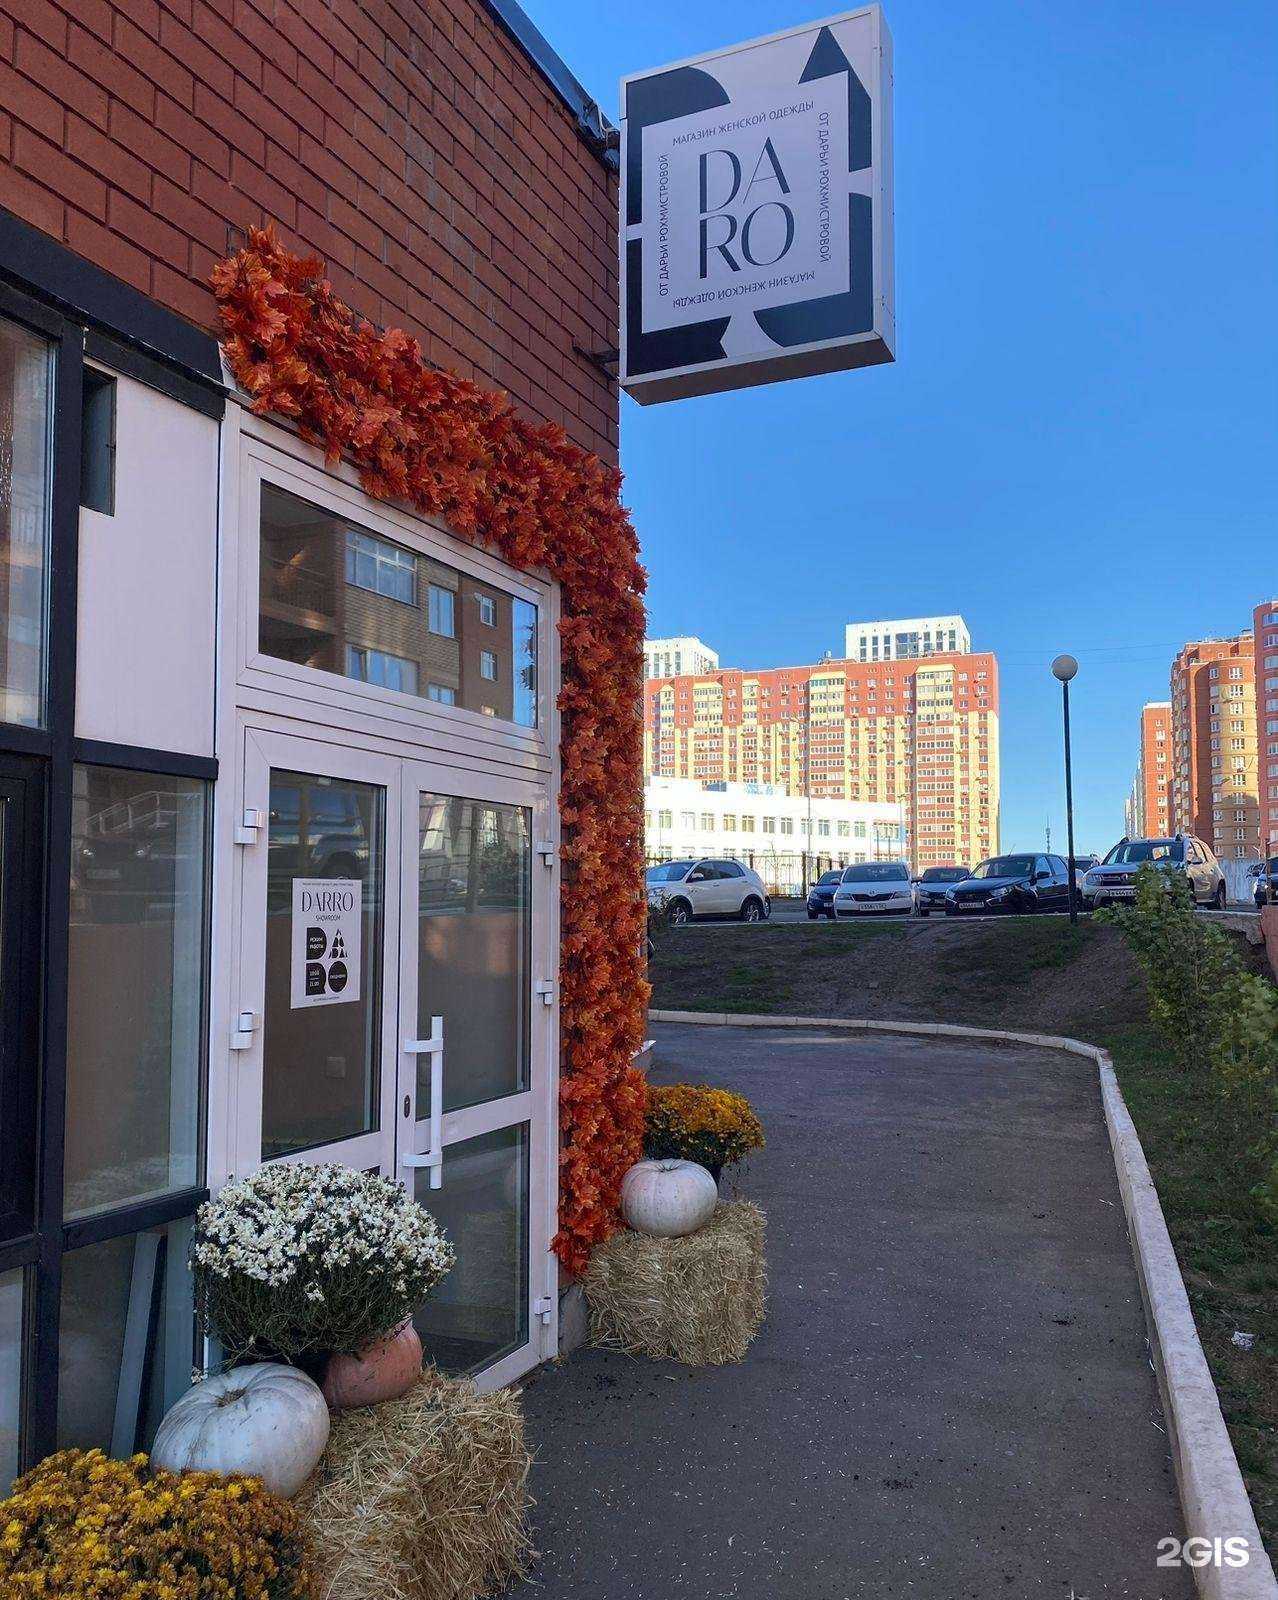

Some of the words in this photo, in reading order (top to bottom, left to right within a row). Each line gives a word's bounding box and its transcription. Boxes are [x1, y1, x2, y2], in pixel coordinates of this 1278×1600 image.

[672, 126, 716, 146] МАГАЗИН
[718, 111, 767, 133] ЖЕНСКОЙ
[768, 100, 814, 120] ОДЕЖДЫ
[818, 112, 829, 126] ОТ
[818, 129, 829, 167] ДАРЬИ
[700, 136, 791, 214] DA
[658, 154, 669, 242] РОХМИСТРОВОЙ
[819, 170, 831, 263] РОХМИСТРОВОЙ
[699, 201, 795, 279] RO
[659, 243, 669, 280] ДАРЬИ
[768, 270, 815, 288] МАГАЗИН
[659, 282, 669, 297] ОТ
[672, 291, 716, 309] ОДЕЖДЫ
[717, 281, 767, 299] ЖЕНСКОЙ
[302, 891, 354, 912] DARRO
